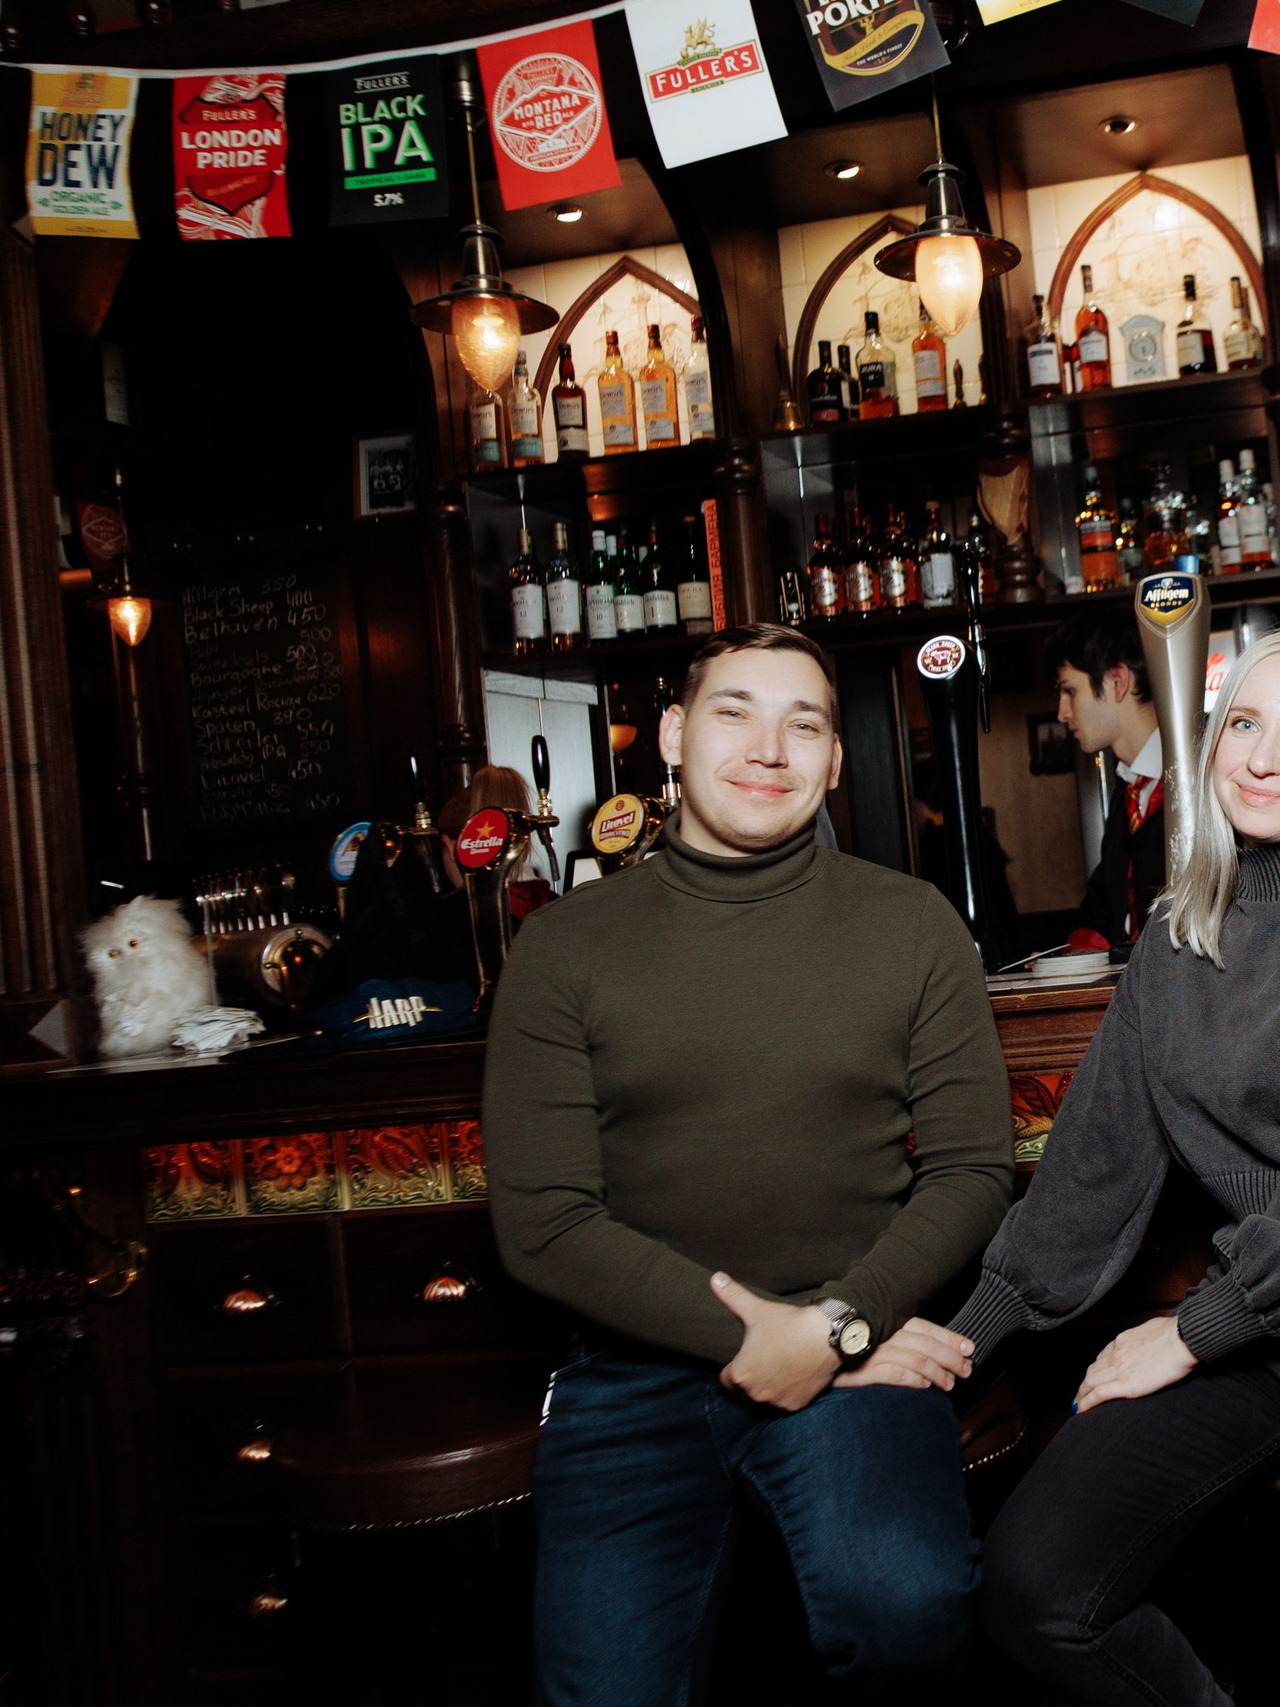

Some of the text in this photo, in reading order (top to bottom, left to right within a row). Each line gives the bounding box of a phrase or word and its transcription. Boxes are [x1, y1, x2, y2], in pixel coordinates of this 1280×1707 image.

[806, 0, 894, 35] POR
[655, 50, 753, 92] FULLER'S
[339, 93, 428, 126] BLACK
[513, 93, 582, 121] MONTANA
[535, 111, 562, 130] RED
[39, 111, 126, 142] HONEY
[180, 128, 282, 149] LONDON
[196, 149, 268, 169] PRIDE
[341, 119, 435, 171] IPA
[37, 142, 123, 189] DEW
[261, 574, 298, 594] 350
[1143, 588, 1189, 602] Affligem
[184, 606, 225, 625] Black
[229, 598, 275, 618] Sheep
[1150, 600, 1182, 609] BLONDE
[184, 603, 327, 645] Belhaven 450
[191, 698, 251, 720] Kasteel
[306, 683, 342, 703] 620
[194, 707, 313, 740] Spaten 390
[601, 812, 634, 832] Litovel
[460, 836, 504, 850] Estrella
